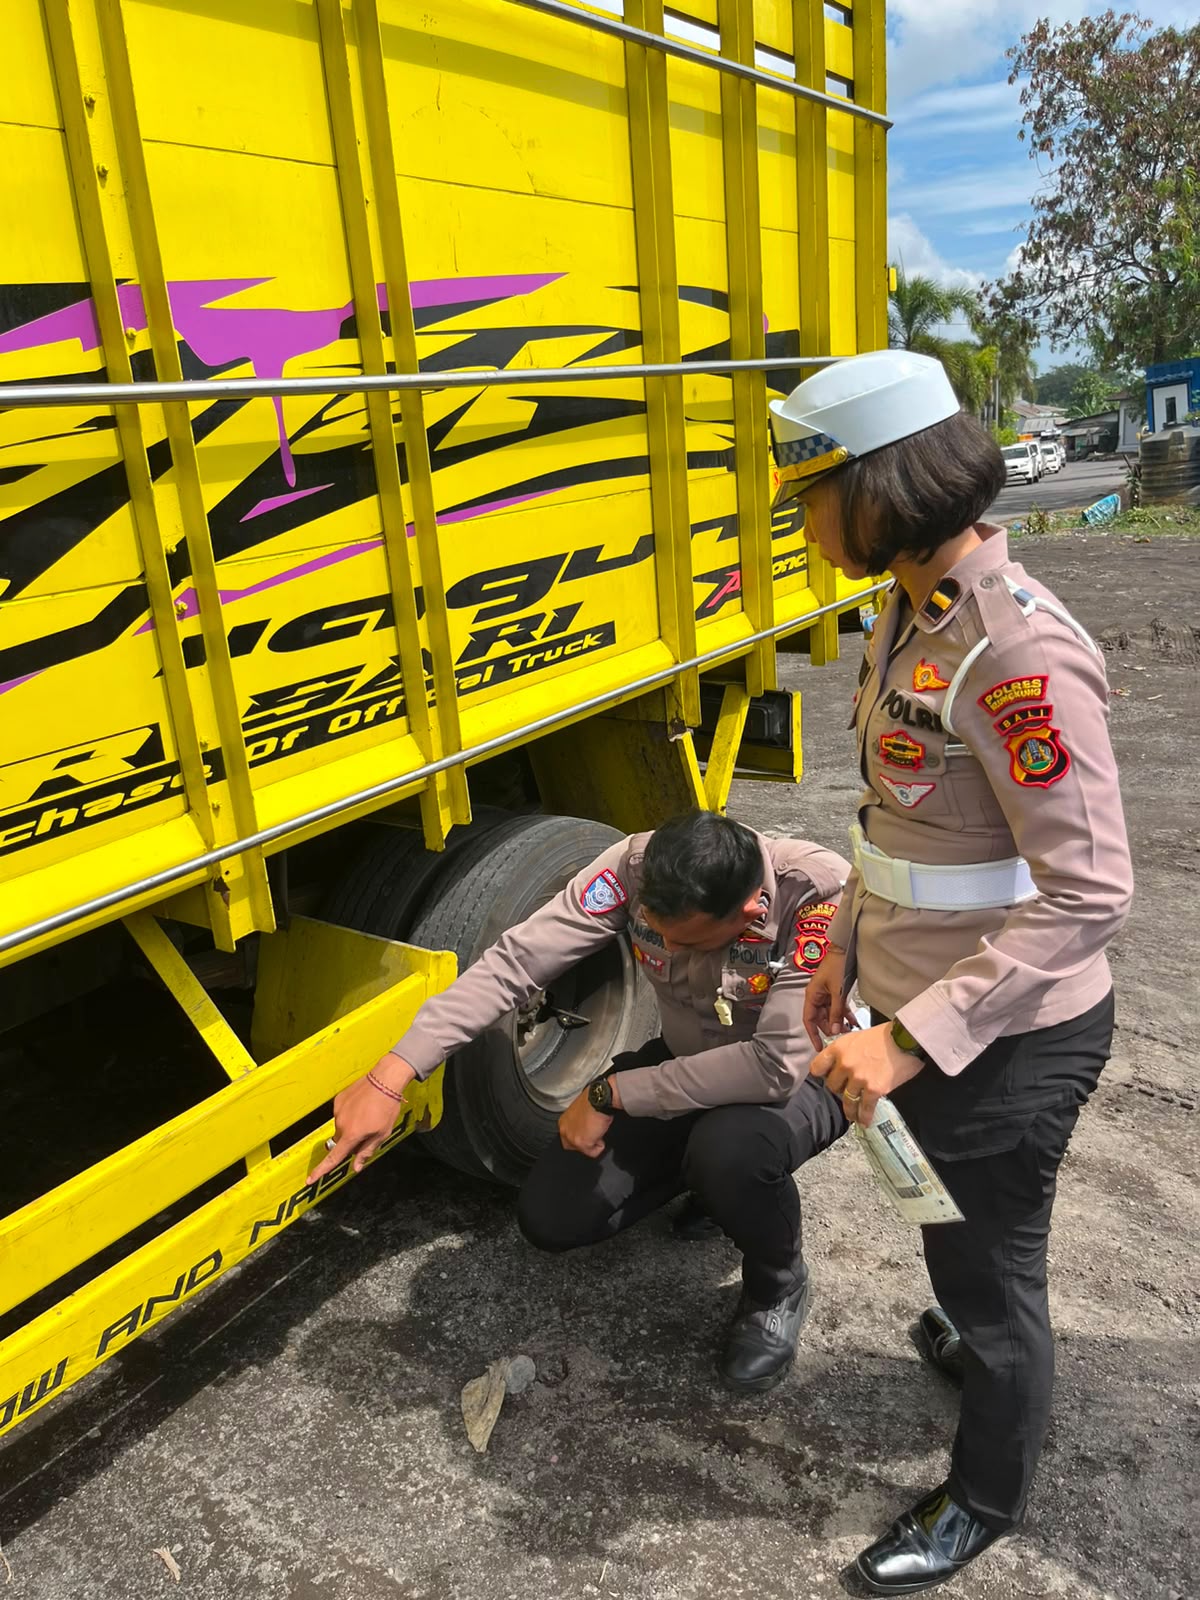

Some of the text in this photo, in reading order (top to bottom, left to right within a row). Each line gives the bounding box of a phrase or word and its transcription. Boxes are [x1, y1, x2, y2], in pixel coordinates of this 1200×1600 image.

[508, 633, 604, 673] Truck
[881, 689, 943, 733] POLRI
[984, 679, 1042, 705] POLRES
[1002, 709, 1044, 728] BALI
[96, 1249, 224, 1360] AND
